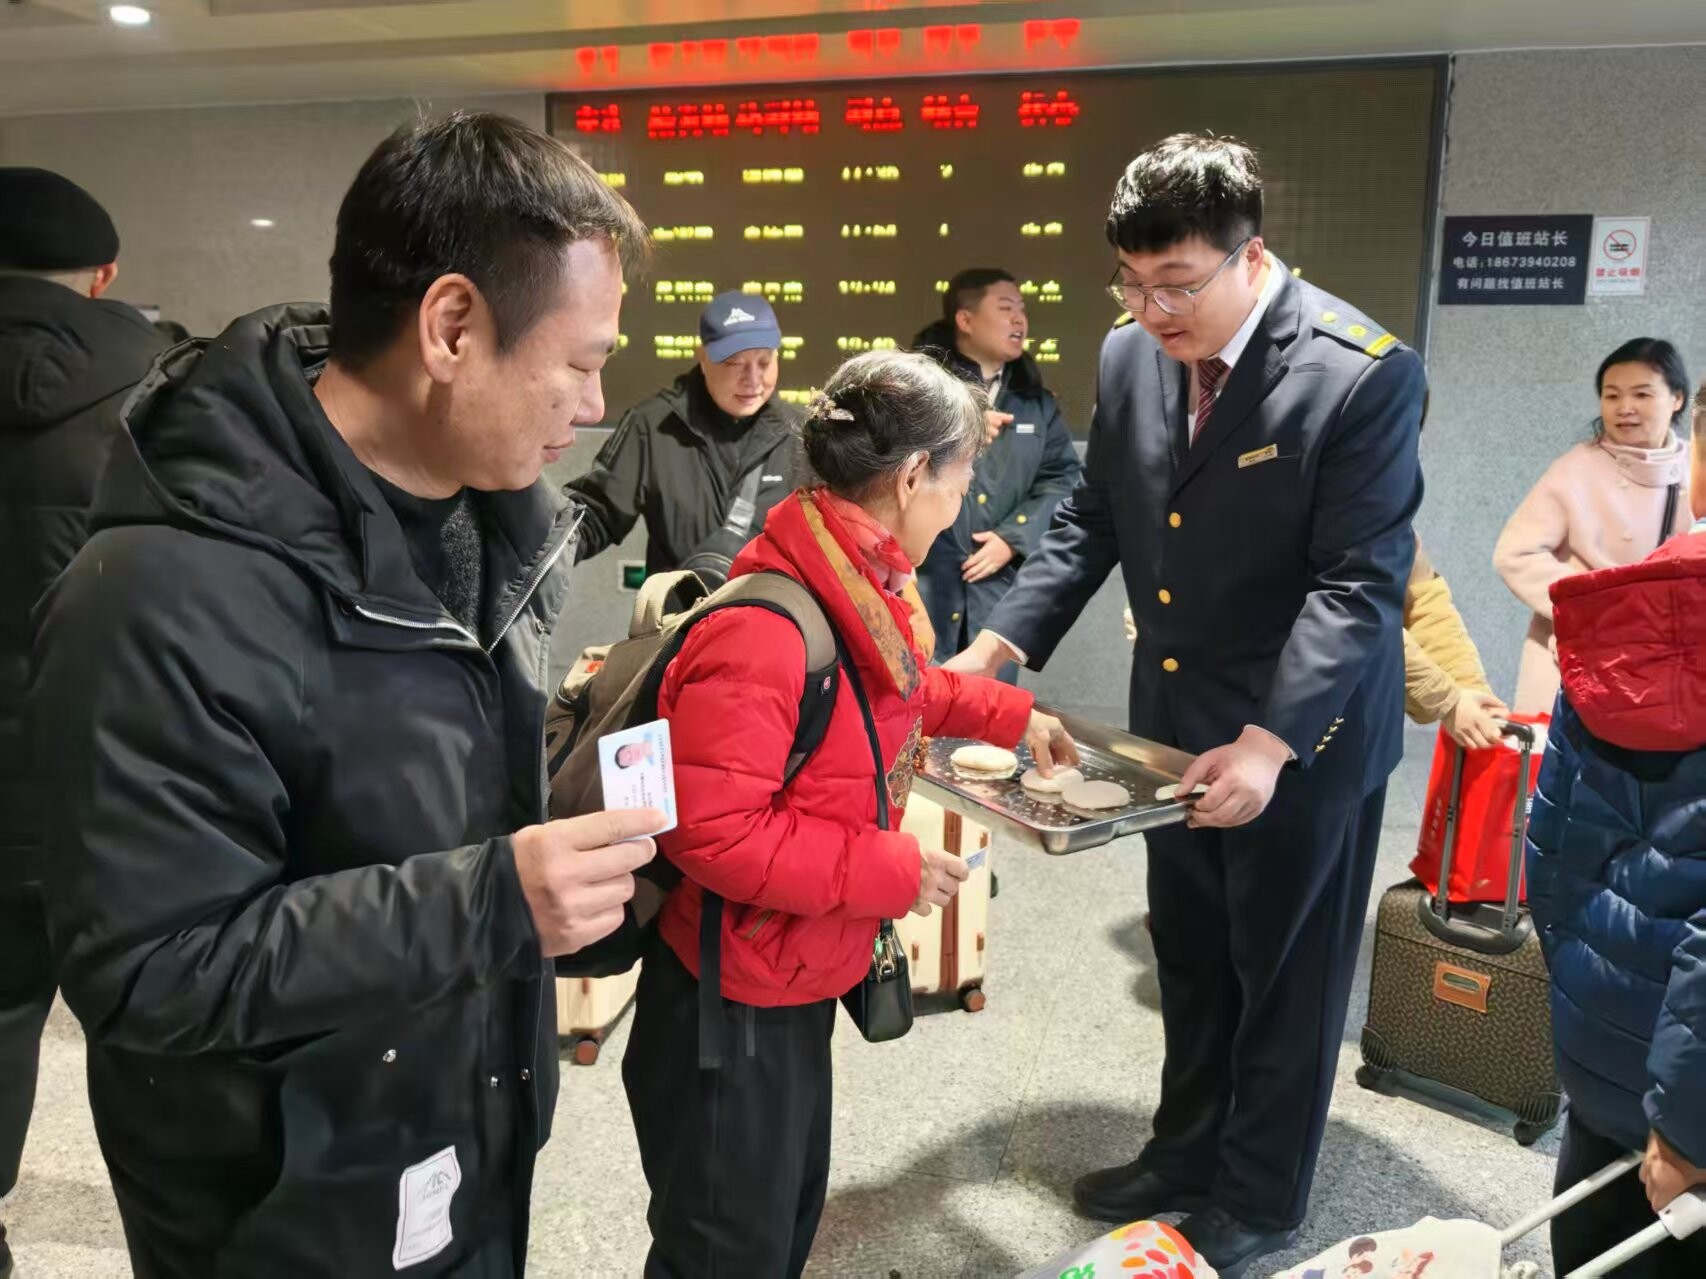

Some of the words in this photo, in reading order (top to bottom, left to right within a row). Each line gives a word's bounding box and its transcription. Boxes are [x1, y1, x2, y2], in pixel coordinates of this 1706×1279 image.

[1461, 230, 1569, 248] 今日值班站长
[1456, 277, 1565, 290] 有问题找值班站长
